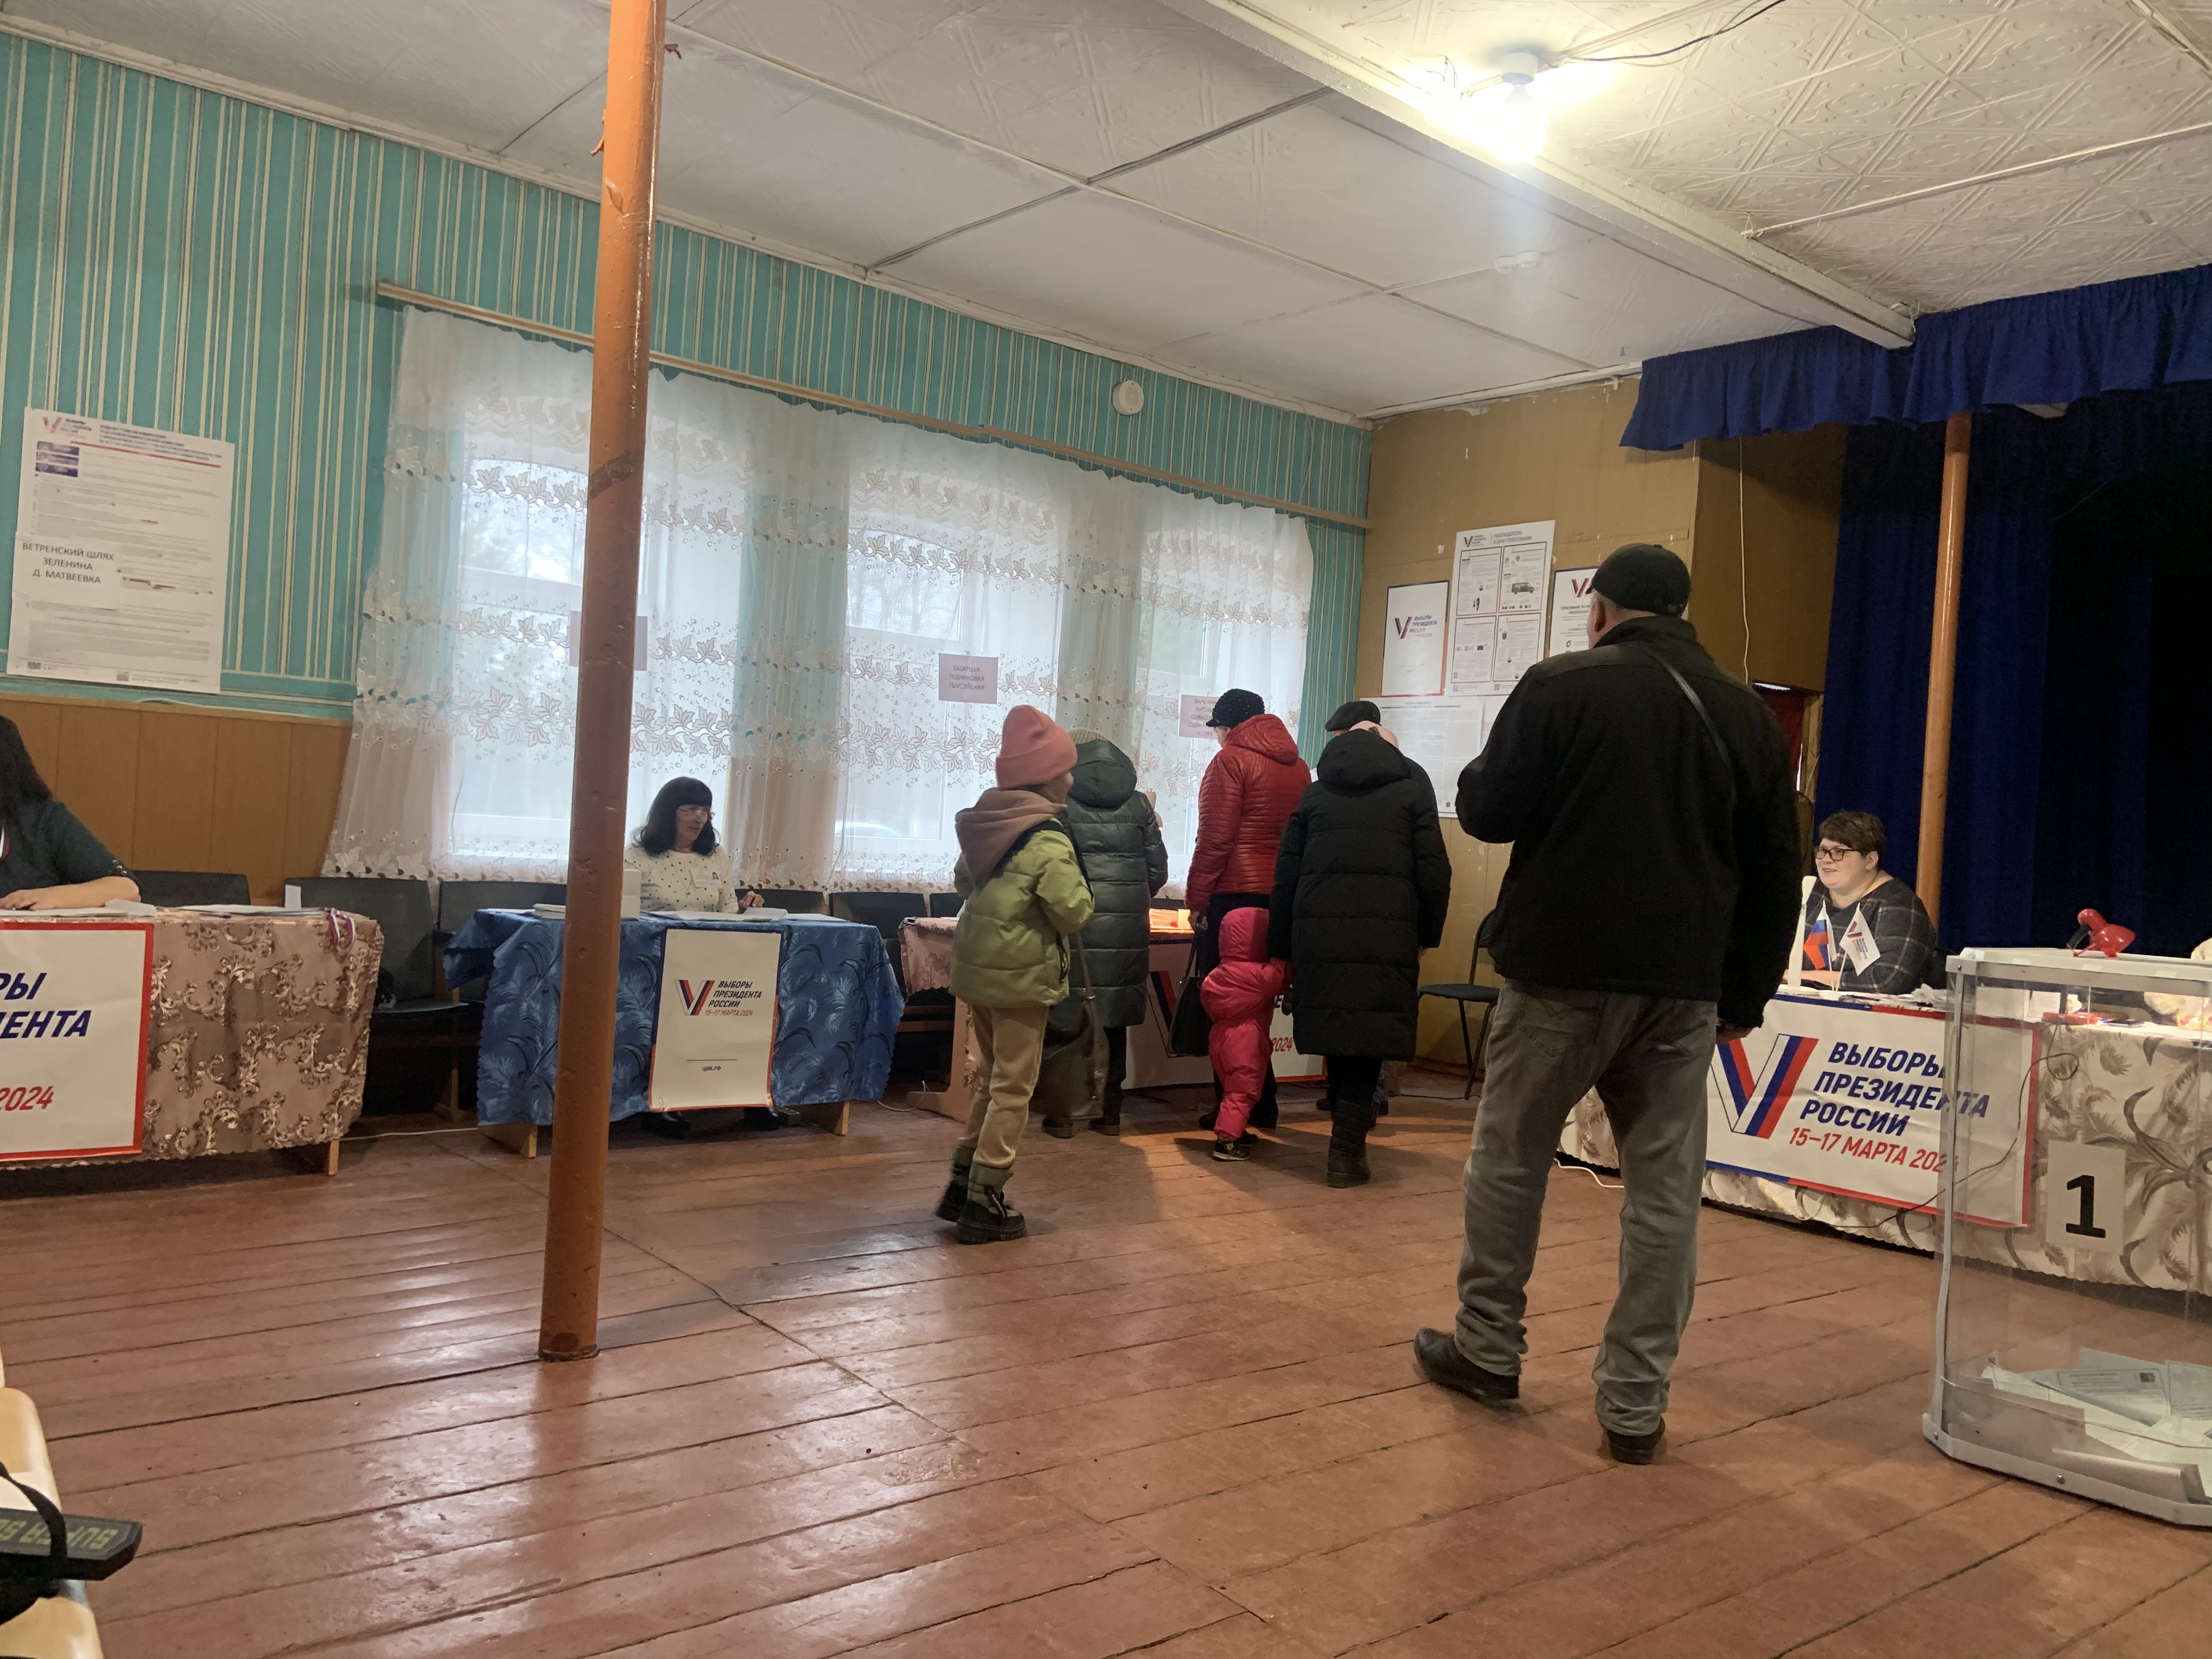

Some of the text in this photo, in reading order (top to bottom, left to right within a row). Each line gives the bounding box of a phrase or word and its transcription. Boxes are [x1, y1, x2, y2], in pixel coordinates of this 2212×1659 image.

[22, 543, 115, 561] ВЕТРЕНСКИЙ ШЛЯХ
[42, 557, 93, 571] ЗЕЛЕНИНА
[46, 570, 101, 584] МАТВЕЕВКА
[949, 673, 985, 681] РОДНИКОВАЯ
[718, 980, 753, 989] ВЫБОРЫ
[713, 990, 762, 999] ПРЕЗИДЕНТА
[0, 1010, 92, 1039] ЕНТА
[0, 1086, 54, 1111] 2024
[1799, 1099, 1910, 1136] РОССИИ
[1841, 1136, 1908, 1166] МАРТА
[2066, 1175, 2106, 1238] 1
